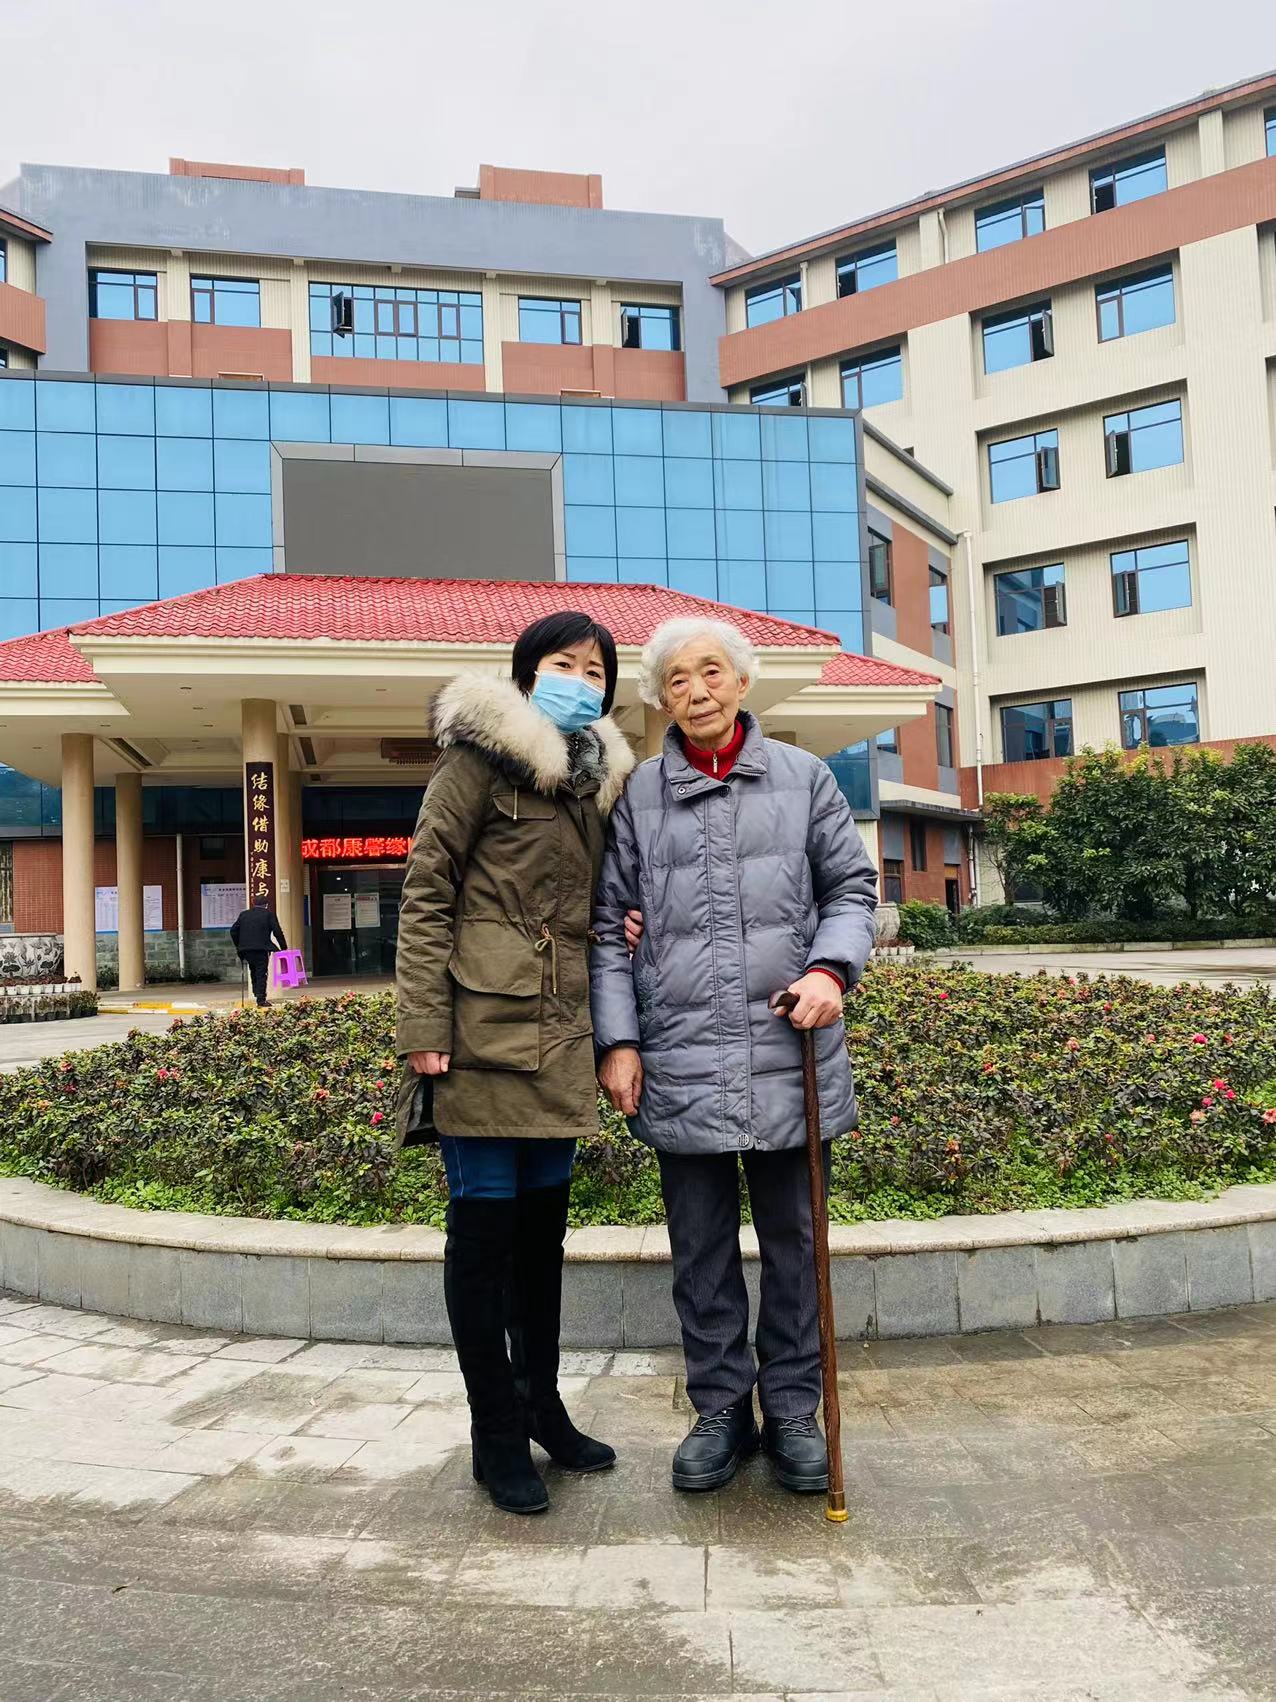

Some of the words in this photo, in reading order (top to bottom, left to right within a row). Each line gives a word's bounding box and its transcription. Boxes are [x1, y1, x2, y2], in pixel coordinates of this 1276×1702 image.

[251, 772, 271, 909] 结缘借助康与
[302, 837, 412, 858] 成都康馨缘
